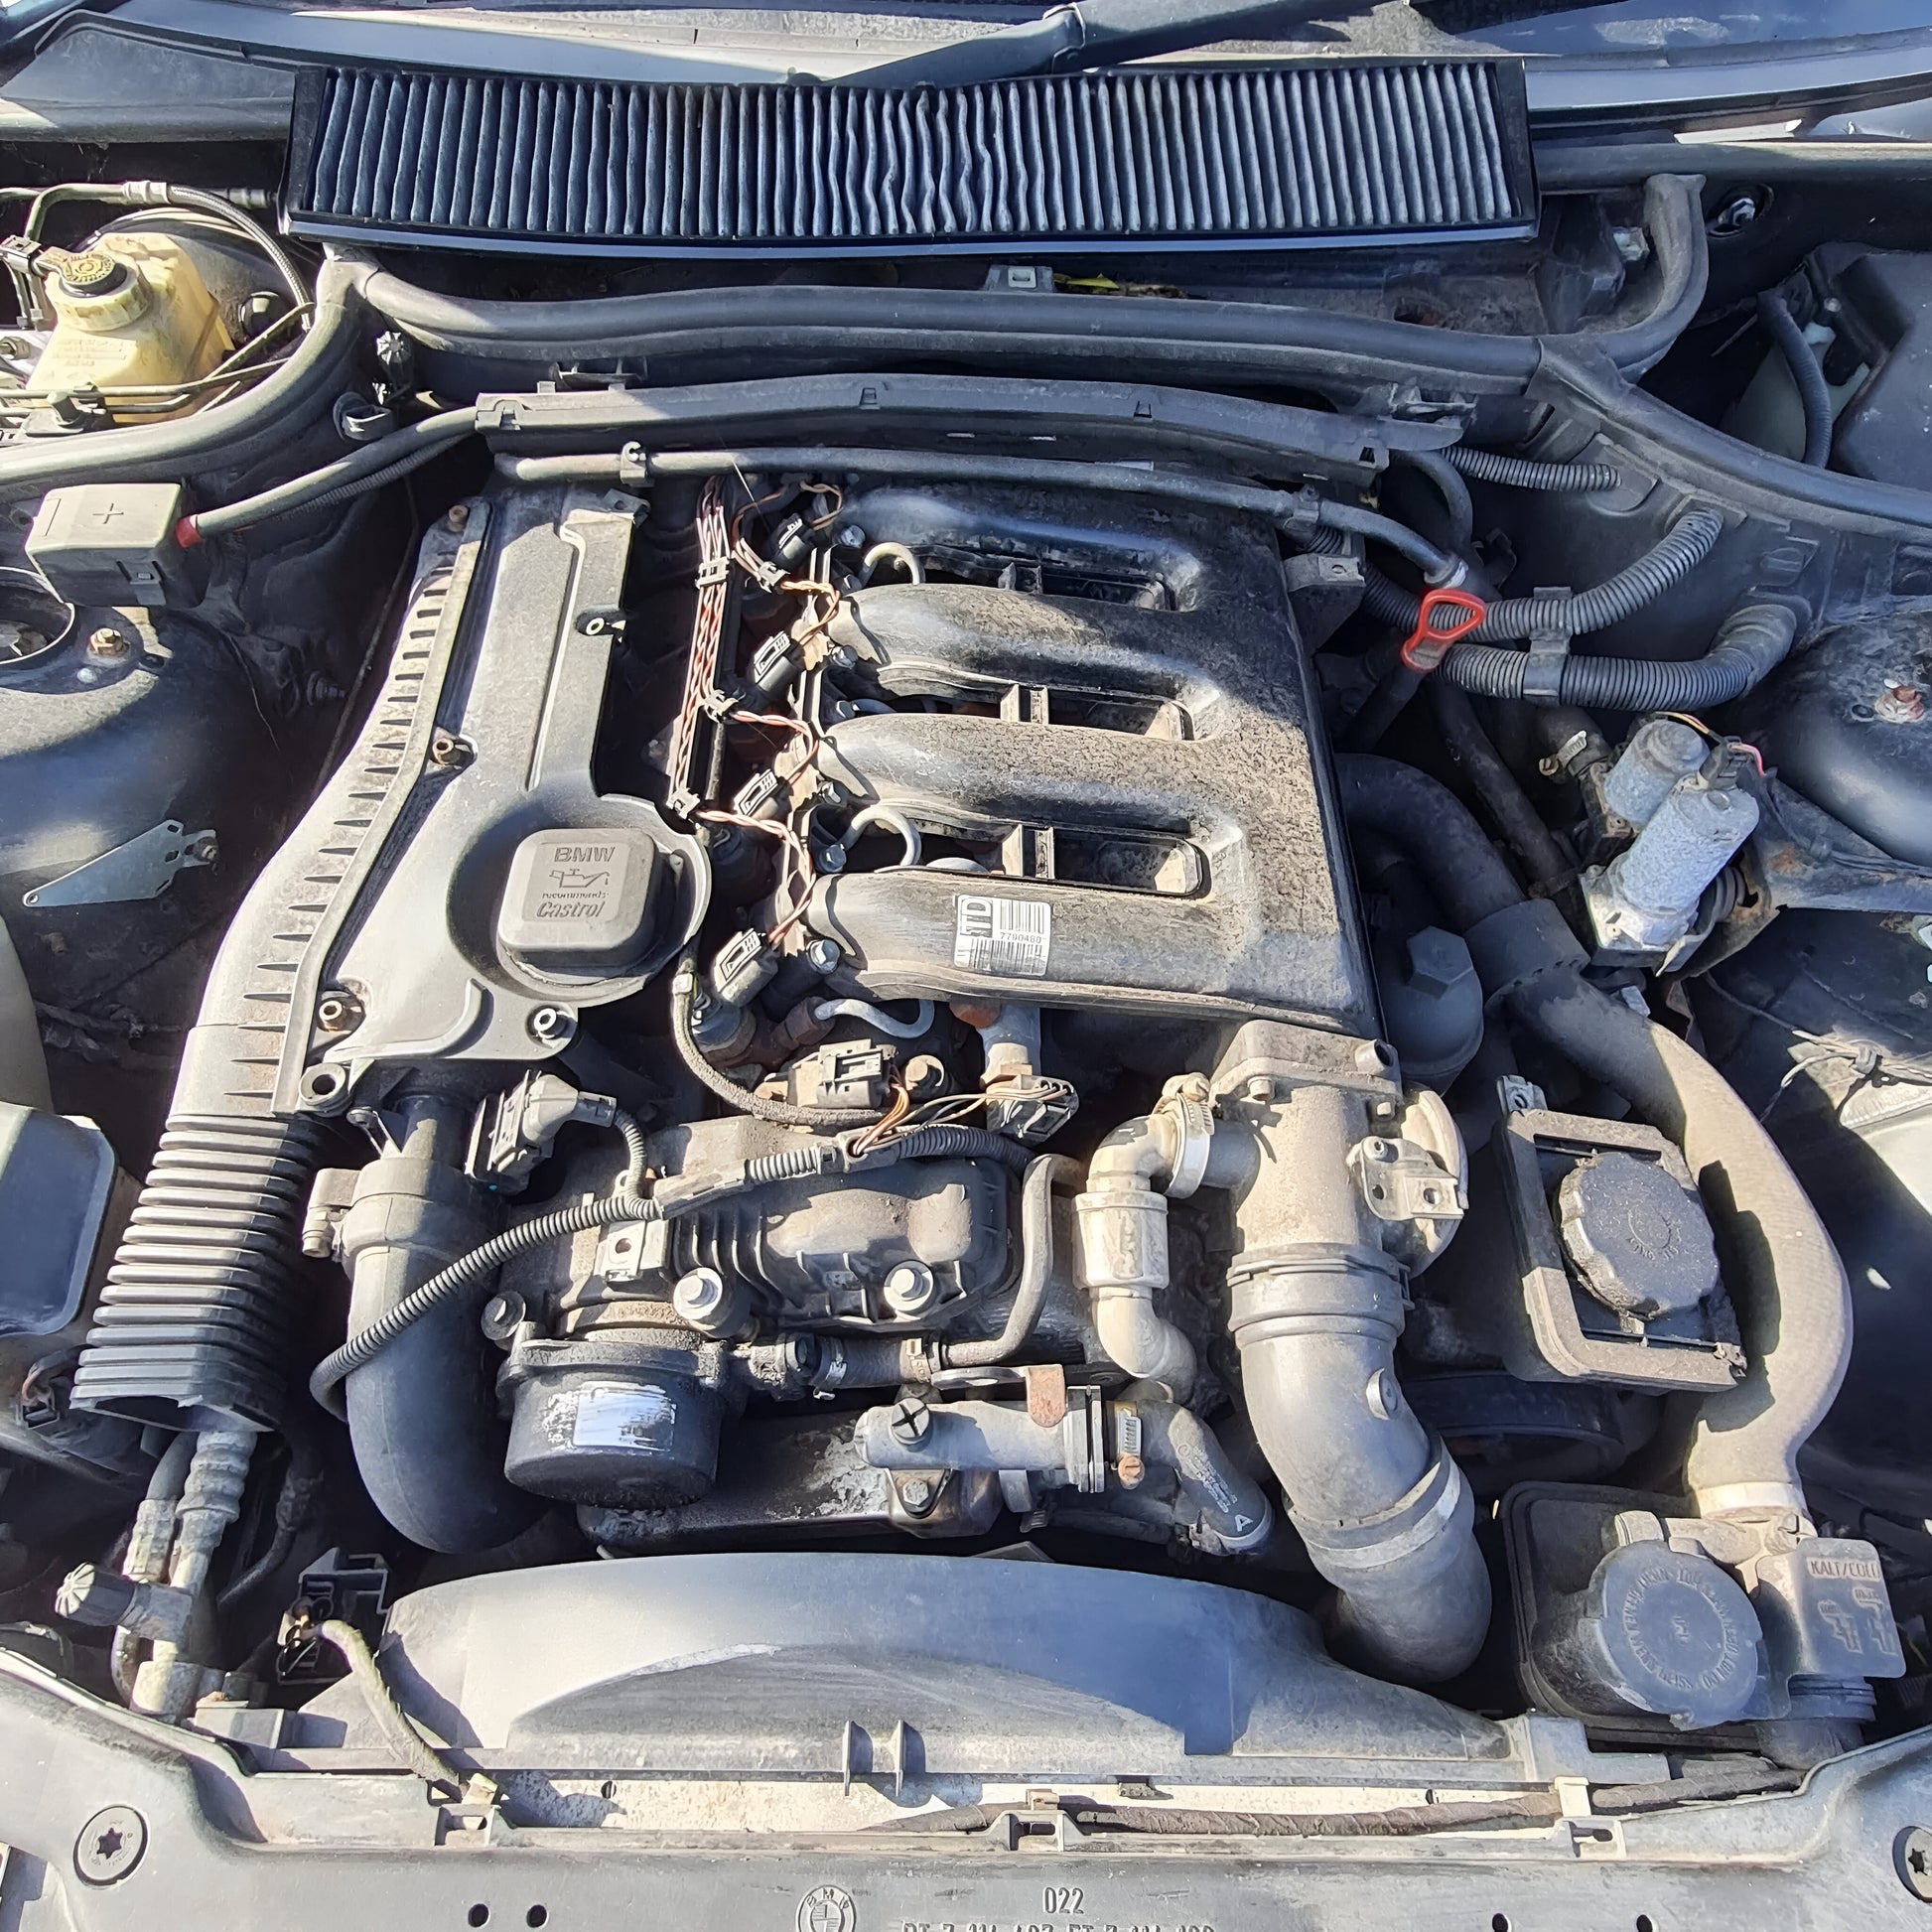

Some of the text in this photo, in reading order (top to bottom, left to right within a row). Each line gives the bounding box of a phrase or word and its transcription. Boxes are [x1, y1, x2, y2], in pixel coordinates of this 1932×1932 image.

[554, 847, 616, 862] BMW
[536, 900, 606, 917] Castrol
[1234, 1514, 1254, 1532] A
[1810, 1560, 1880, 1579] KALT/COLD
[1043, 1886, 1084, 1914] 022
